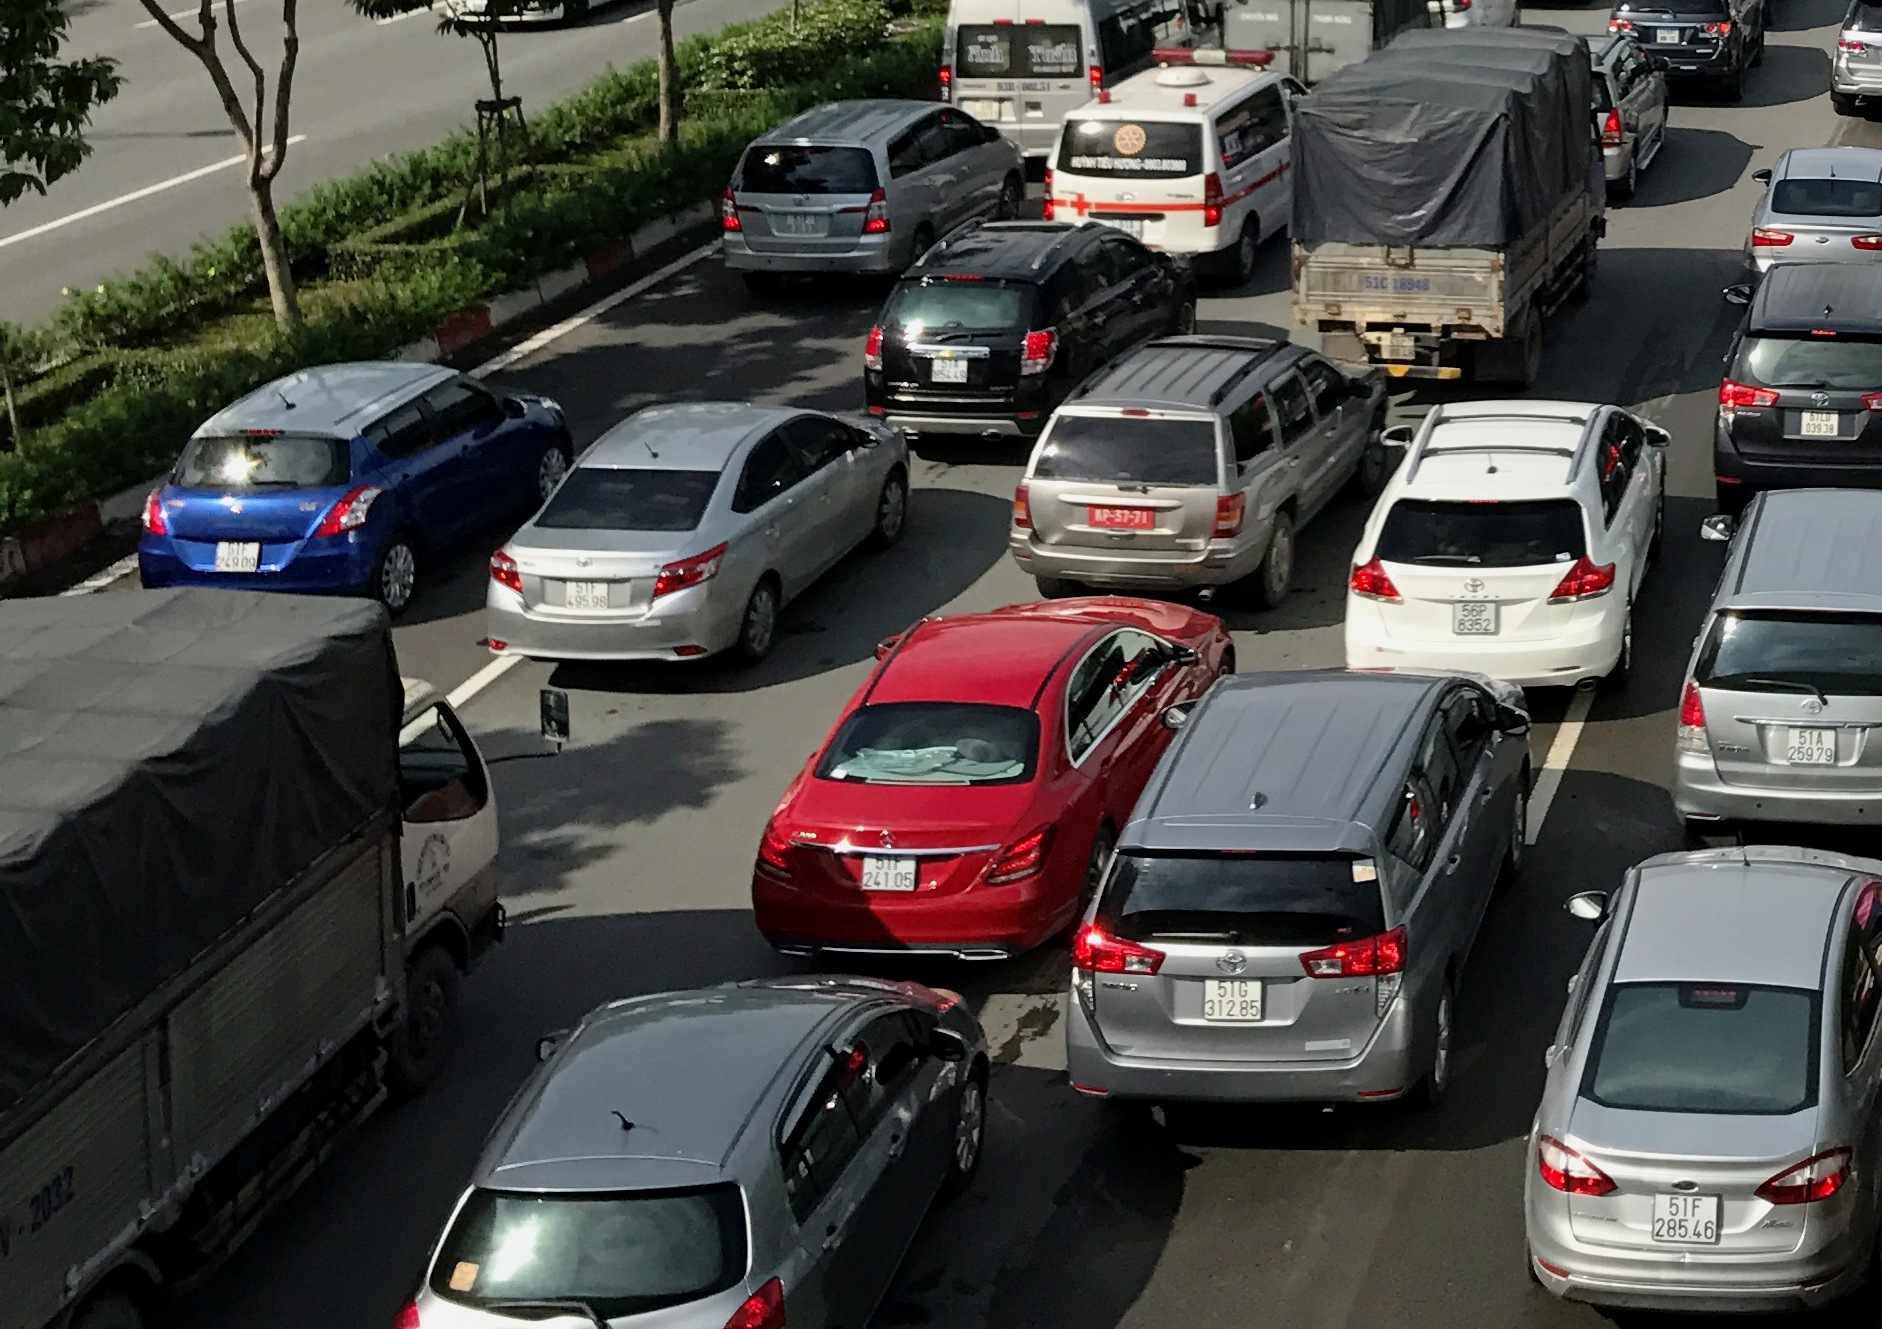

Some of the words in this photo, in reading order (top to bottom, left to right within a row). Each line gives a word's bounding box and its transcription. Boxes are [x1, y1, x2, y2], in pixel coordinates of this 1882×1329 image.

[1462, 604, 1487, 617] 56P
[1799, 730, 1823, 746] 51A
[1218, 981, 1248, 997] 51G
[1669, 1198, 1702, 1217] 51F
